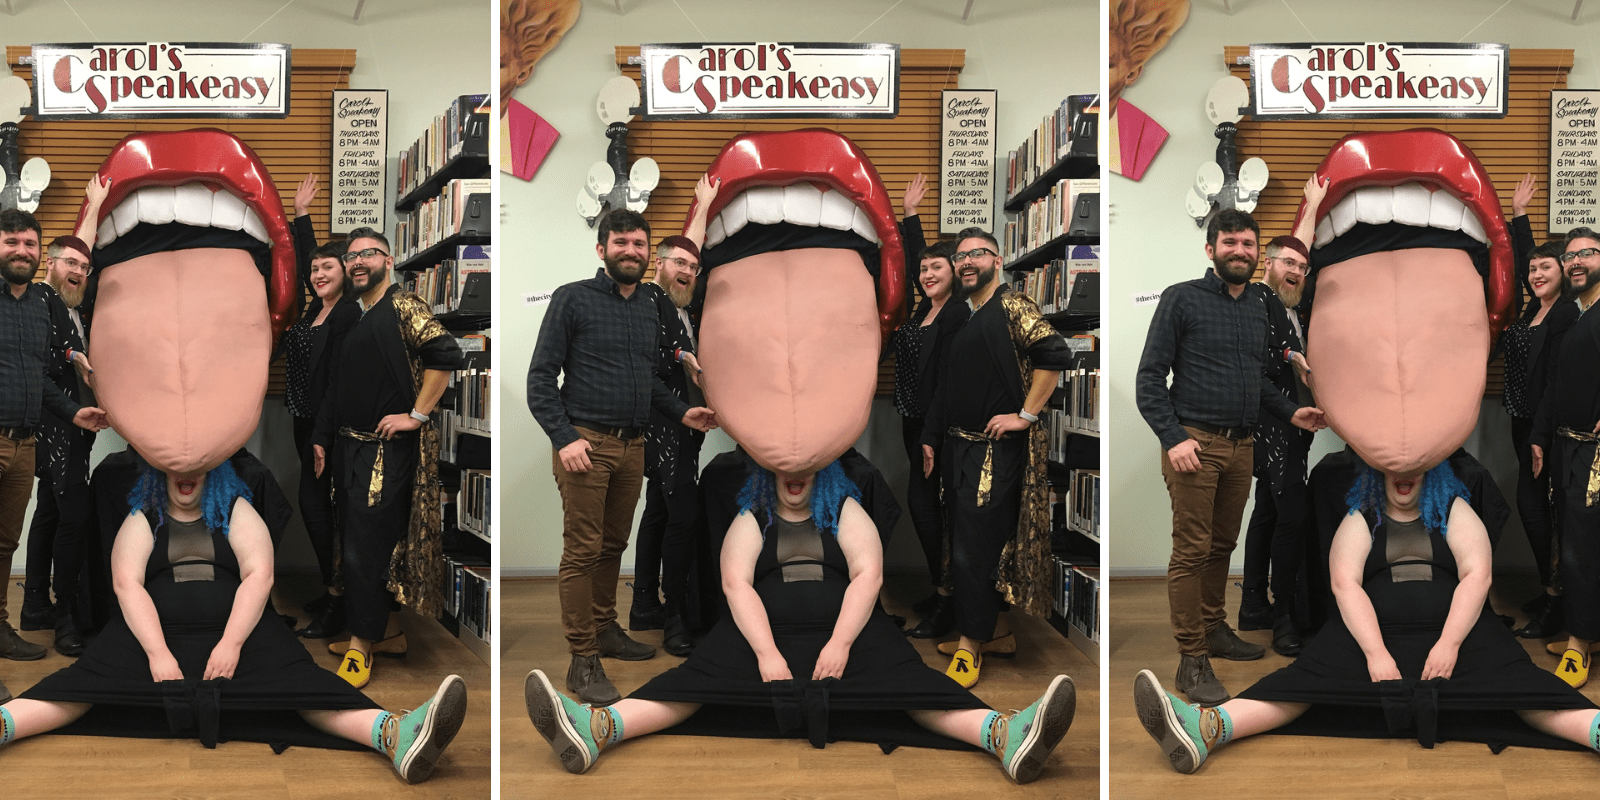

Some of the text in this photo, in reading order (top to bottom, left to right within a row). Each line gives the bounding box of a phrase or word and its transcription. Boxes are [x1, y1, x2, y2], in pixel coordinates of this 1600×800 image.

[53, 44, 182, 93] Carol's
[662, 44, 791, 93] Carol's
[1271, 44, 1400, 93] Carol's
[85, 71, 274, 114] Speakeasy
[694, 71, 883, 114] Speakeasy
[1303, 71, 1492, 114] Speakeasy
[338, 107, 381, 119] Speakeasy
[947, 107, 990, 119] Speakeasy
[1556, 107, 1599, 119] Speakeasy
[351, 119, 378, 128] OPEN
[960, 119, 987, 128] OPEN
[1569, 119, 1596, 128] OPEN
[339, 130, 380, 138] THURSDAYS
[948, 130, 989, 138] THURSDAYS
[1557, 130, 1598, 138] THURSDAYS
[343, 150, 375, 158] FRIDAYS
[952, 150, 984, 158] FRIDAYS
[1561, 150, 1593, 158] FRIDAYS
[338, 170, 381, 178] SATURDAYS
[947, 170, 990, 178] SATURDAYS
[1556, 170, 1599, 178] SATURDAYS
[339, 190, 375, 198] SUNDAYS
[948, 190, 984, 198] SUNDAYS
[1557, 190, 1593, 198] SUNDAYS
[340, 209, 374, 217] MONDAYS
[949, 209, 983, 217] MONDAYS
[1558, 209, 1592, 217] MONDAYS
